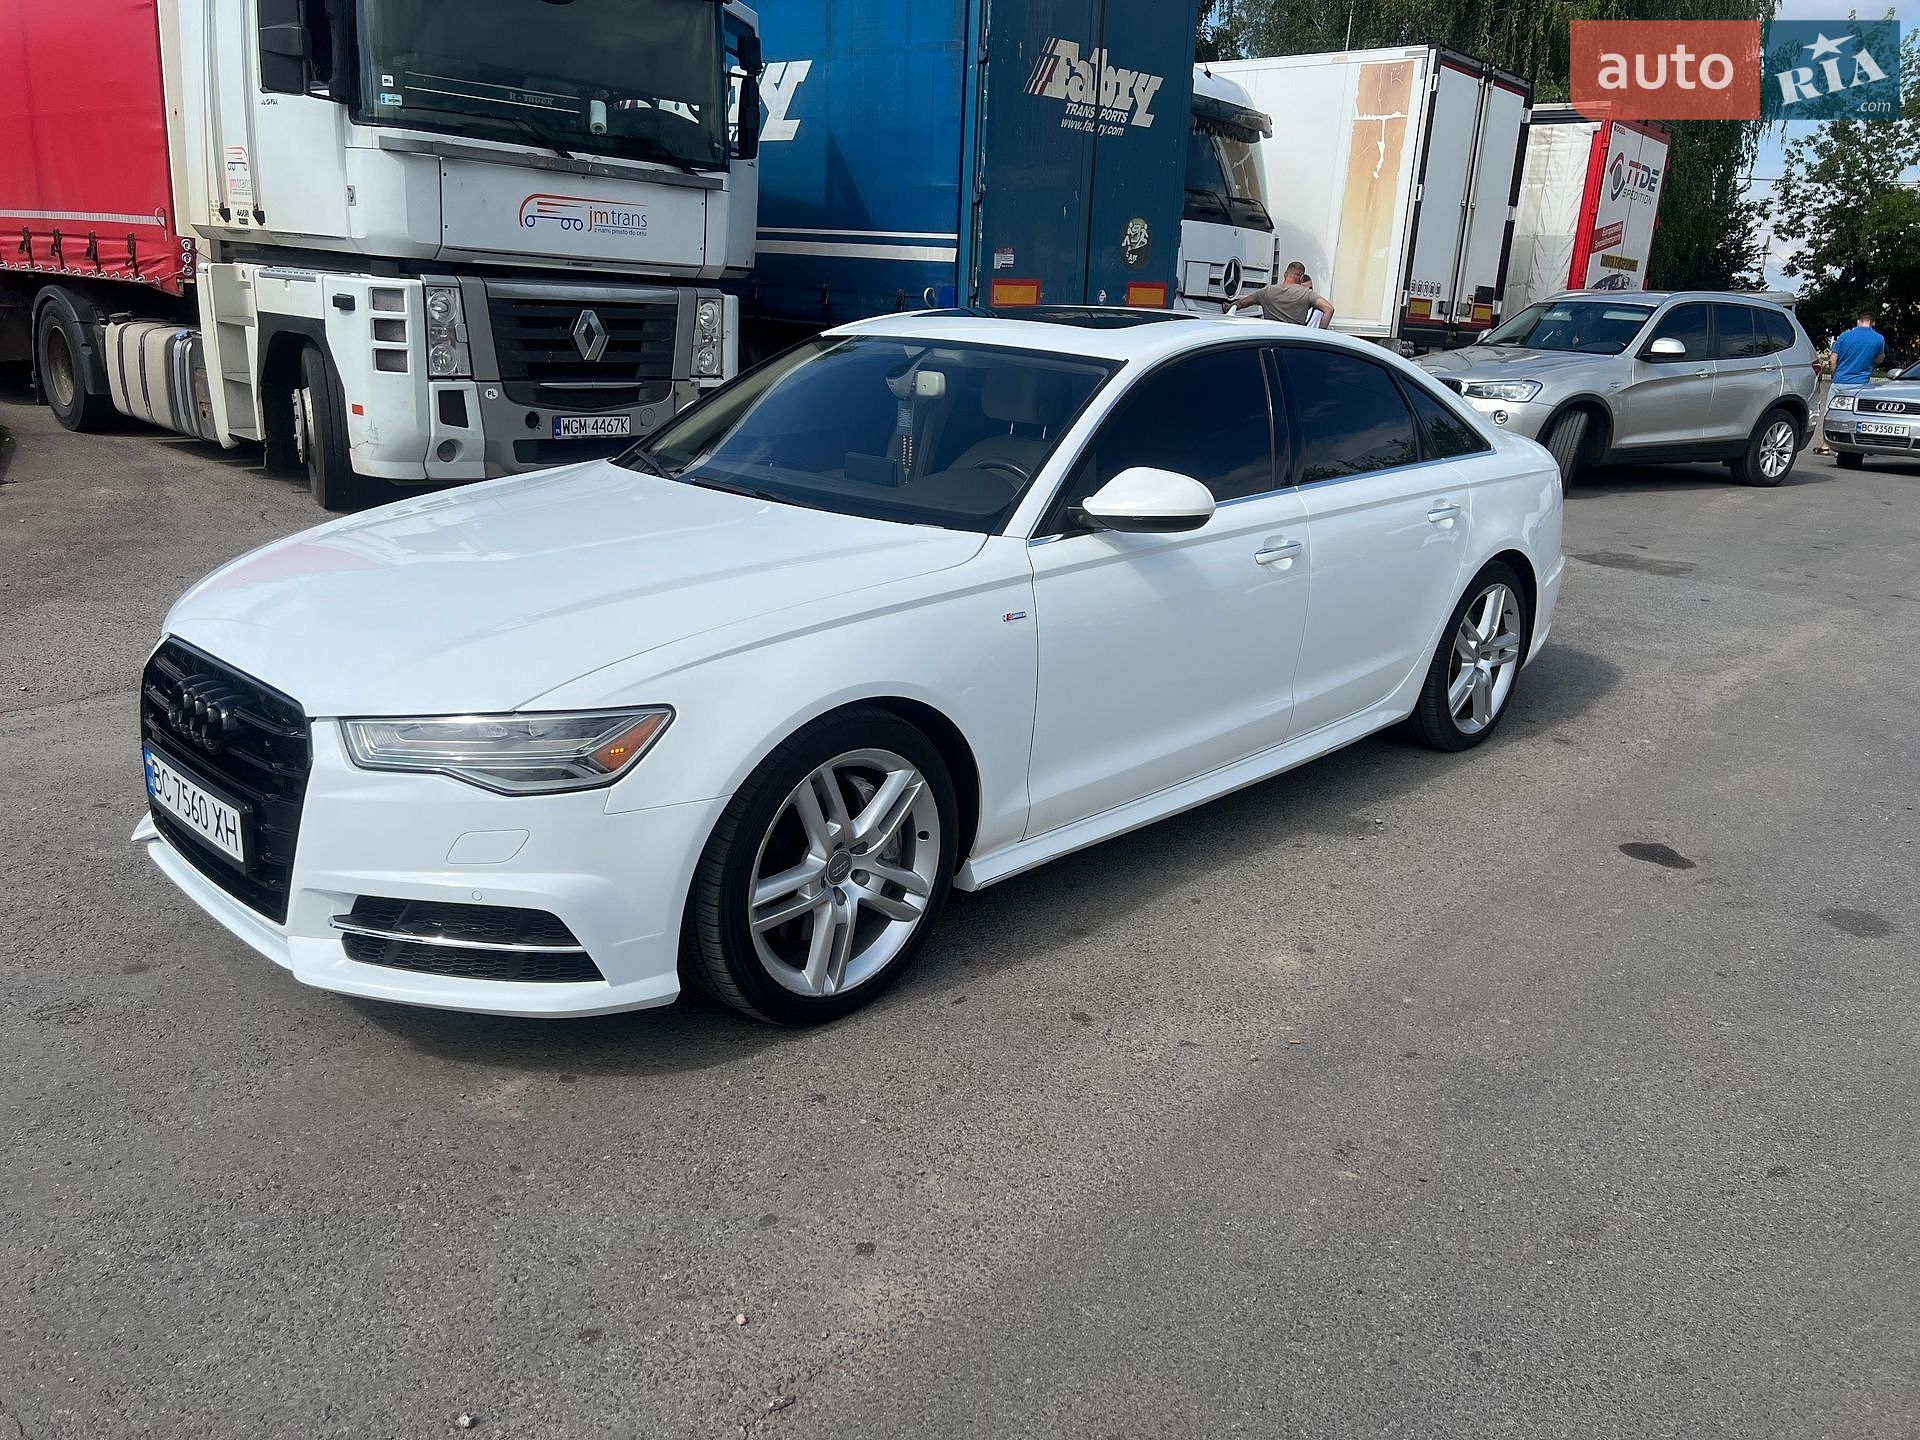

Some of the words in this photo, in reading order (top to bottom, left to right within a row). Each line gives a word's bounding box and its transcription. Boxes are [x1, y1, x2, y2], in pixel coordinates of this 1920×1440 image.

[1622, 188, 1653, 205] SPEDITION
[562, 418, 588, 435] WGM
[591, 417, 629, 434] 4467K
[1861, 423, 1873, 432] BC
[1874, 424, 1893, 433] 9350
[1894, 425, 1907, 435] ET
[152, 758, 172, 802] BC
[173, 775, 209, 831] 7560
[212, 801, 239, 852] XH
